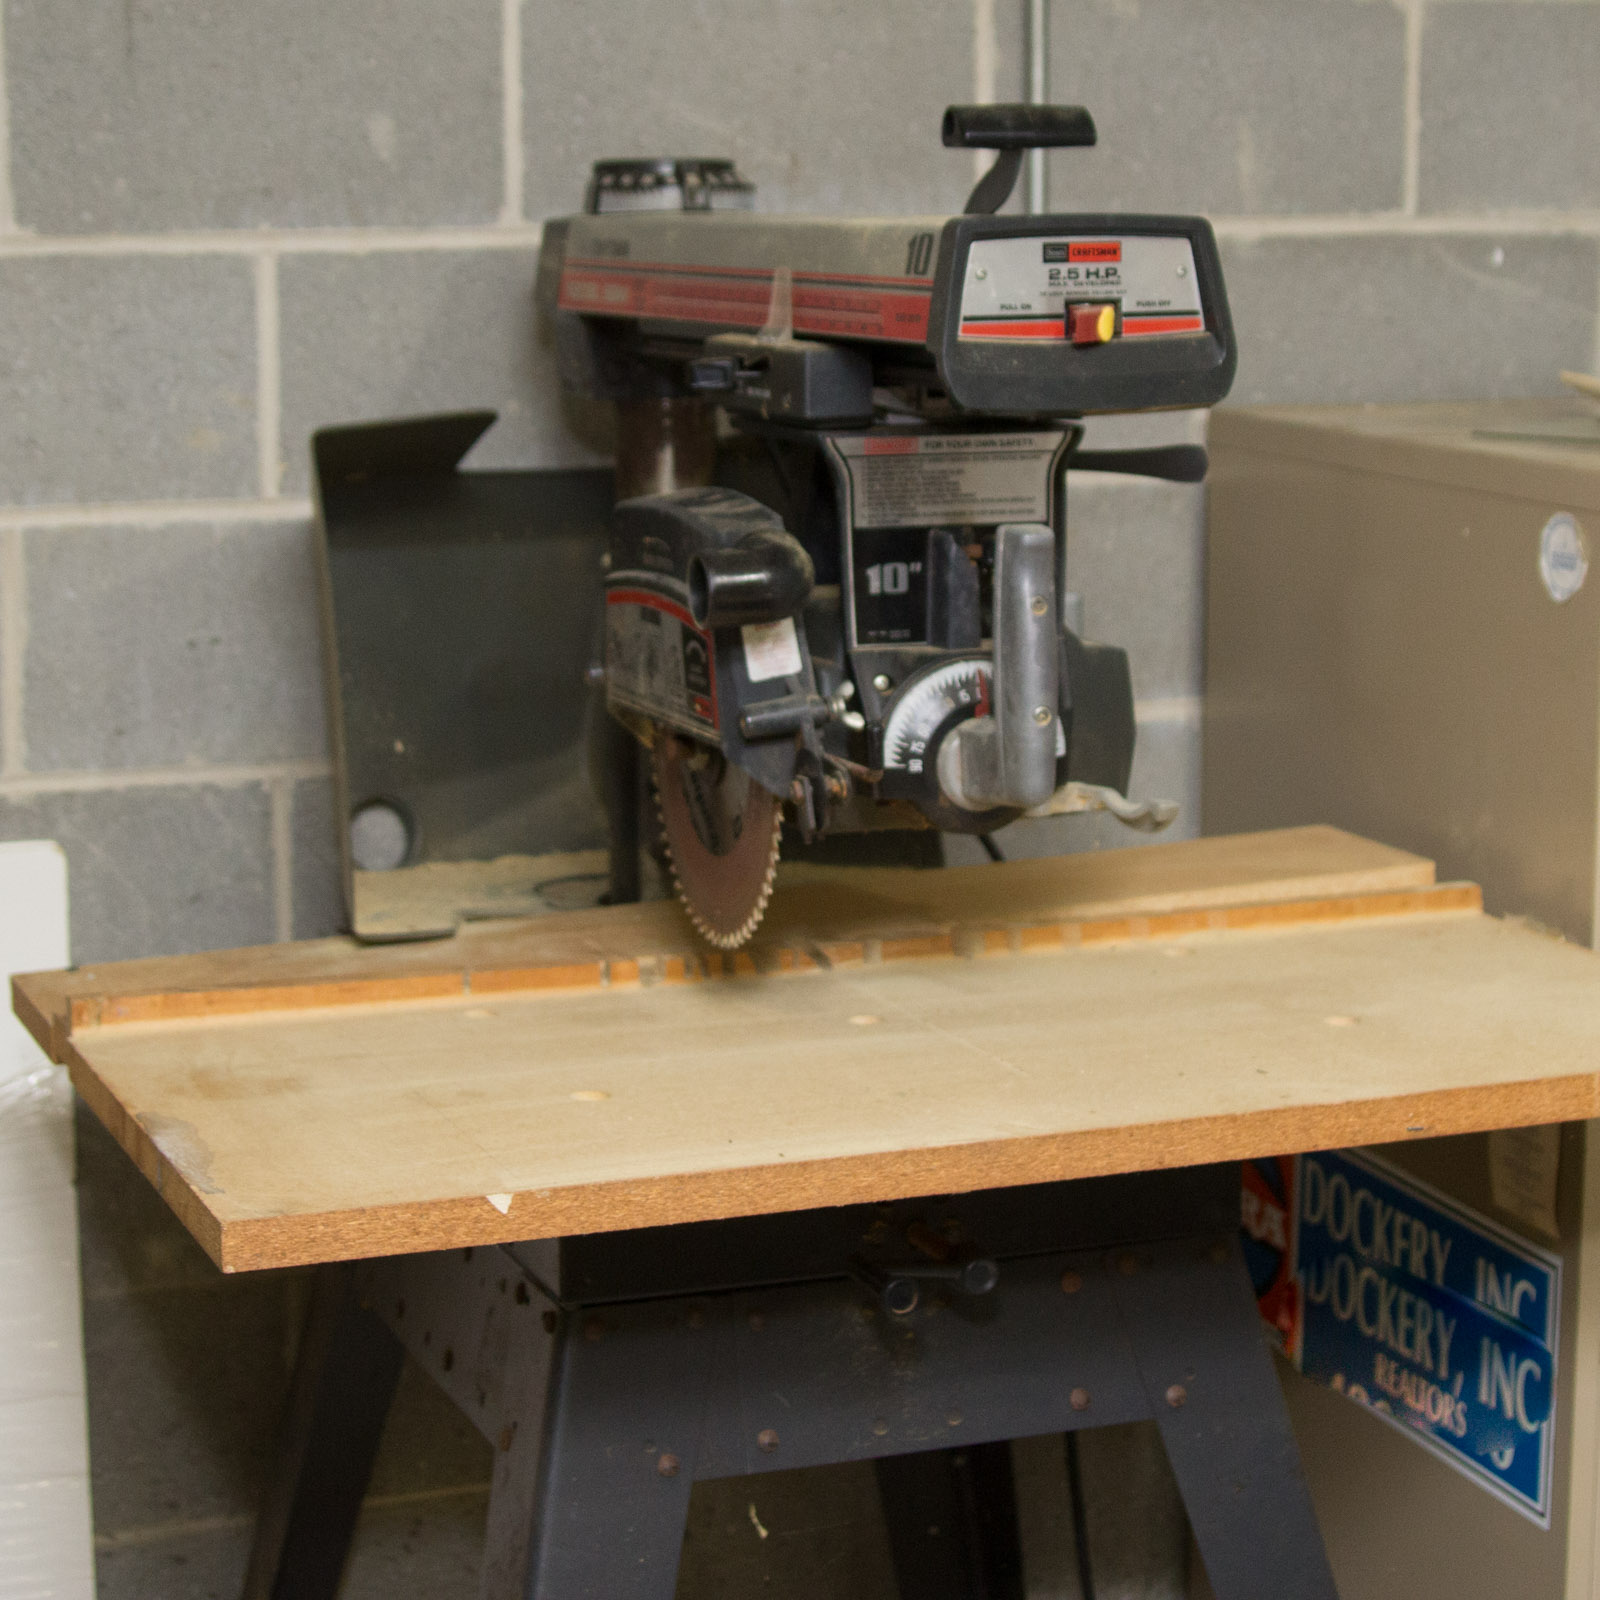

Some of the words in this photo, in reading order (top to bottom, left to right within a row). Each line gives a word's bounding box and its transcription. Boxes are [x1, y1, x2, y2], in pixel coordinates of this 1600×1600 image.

[904, 232, 935, 276] 10
[1071, 246, 1119, 257] CRAFTSMAN
[1048, 267, 1080, 280] 2.5
[1085, 266, 1122, 280] H.P.
